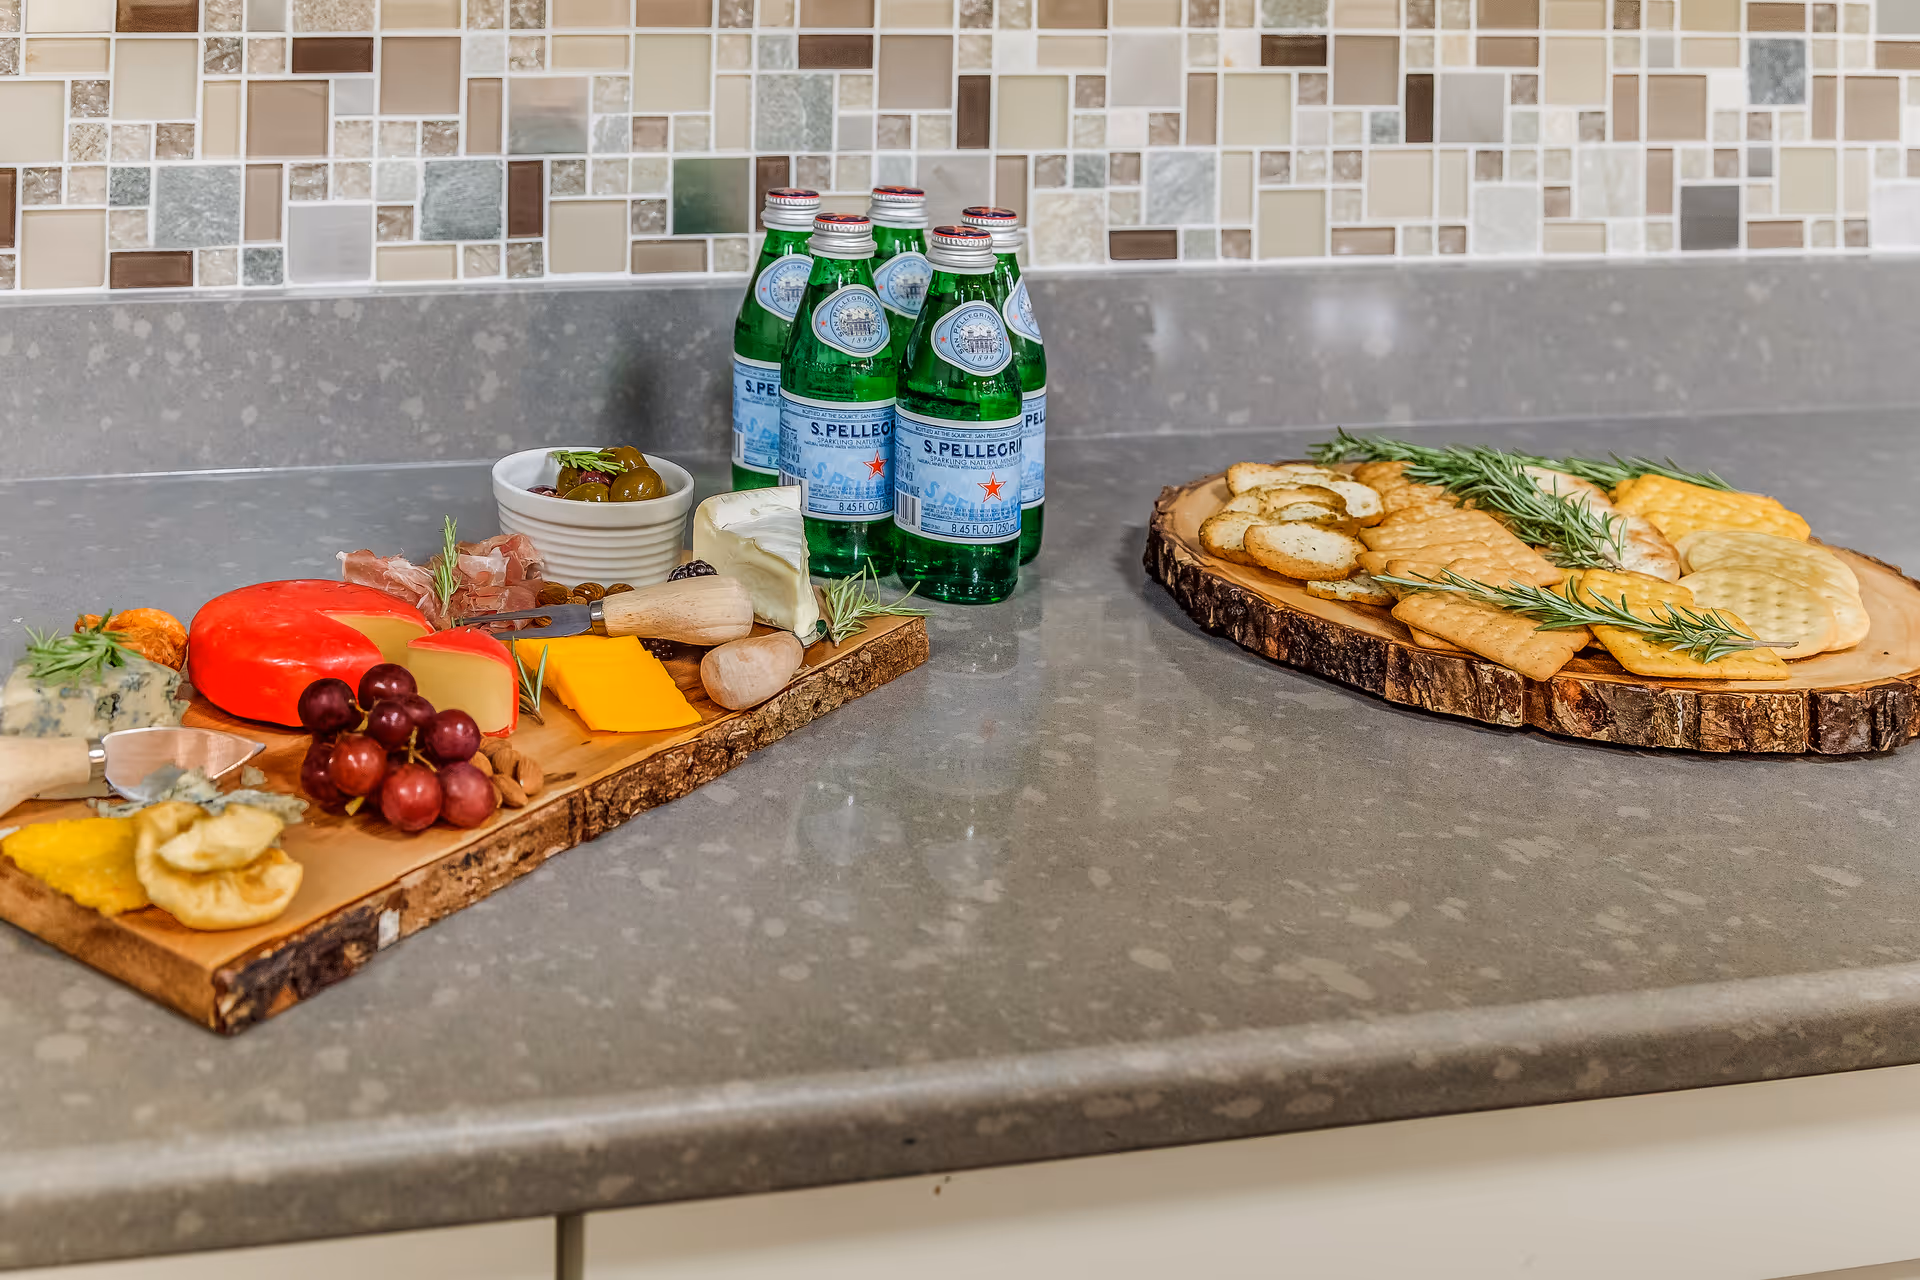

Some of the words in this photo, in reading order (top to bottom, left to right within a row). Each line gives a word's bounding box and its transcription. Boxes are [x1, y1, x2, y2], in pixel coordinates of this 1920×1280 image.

[833, 296, 874, 318] PELLEGRINO
[834, 321, 844, 337] SAN
[953, 312, 996, 334] PELLEGRINO
[954, 338, 964, 355] SAN
[972, 354, 995, 362] 1899
[817, 437, 853, 446] SPARKLING
[856, 438, 884, 446] NATURAL
[929, 455, 968, 466] SPARKLING
[969, 459, 998, 467] NATURAL
[838, 502, 857, 512] 8.45
[858, 503, 866, 512] FL
[867, 502, 878, 511] OZ
[951, 523, 971, 534] 8.45
[972, 525, 980, 534] FL
[981, 524, 994, 534] OZ
[997, 522, 1009, 533] 250
